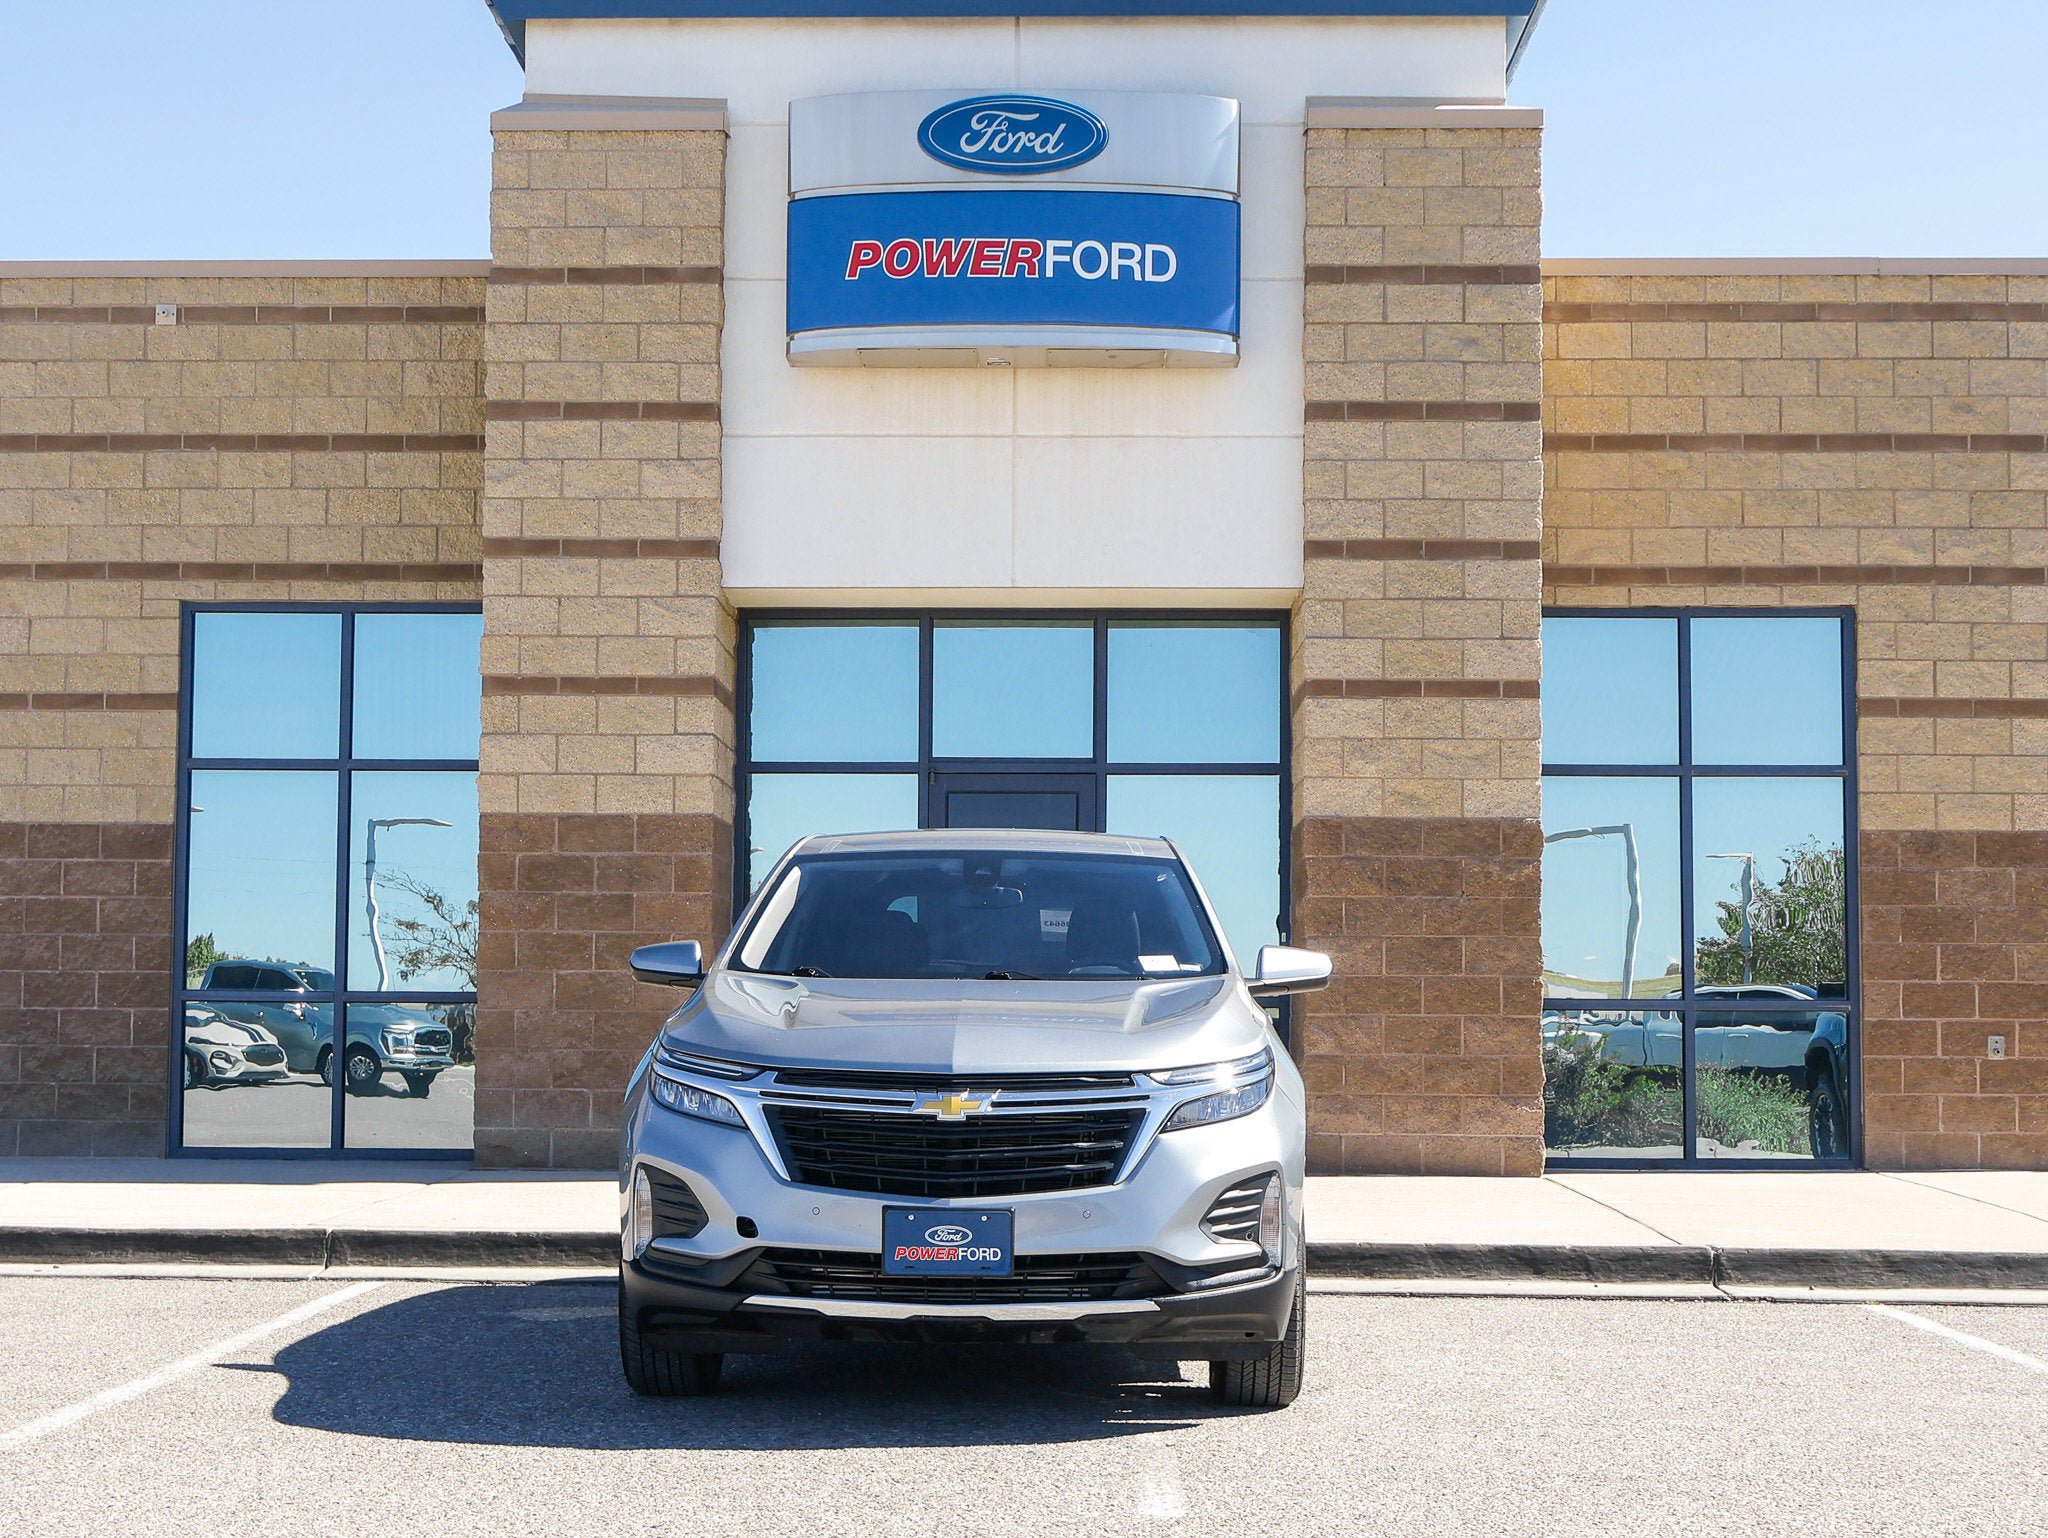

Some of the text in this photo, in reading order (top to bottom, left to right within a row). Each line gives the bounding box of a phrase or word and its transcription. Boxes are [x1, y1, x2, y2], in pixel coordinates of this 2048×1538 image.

[960, 111, 1067, 154] Ford
[845, 238, 1177, 282] POWERFORD
[934, 1229, 963, 1241] Ford
[895, 1246, 1001, 1261] POWERFORD
